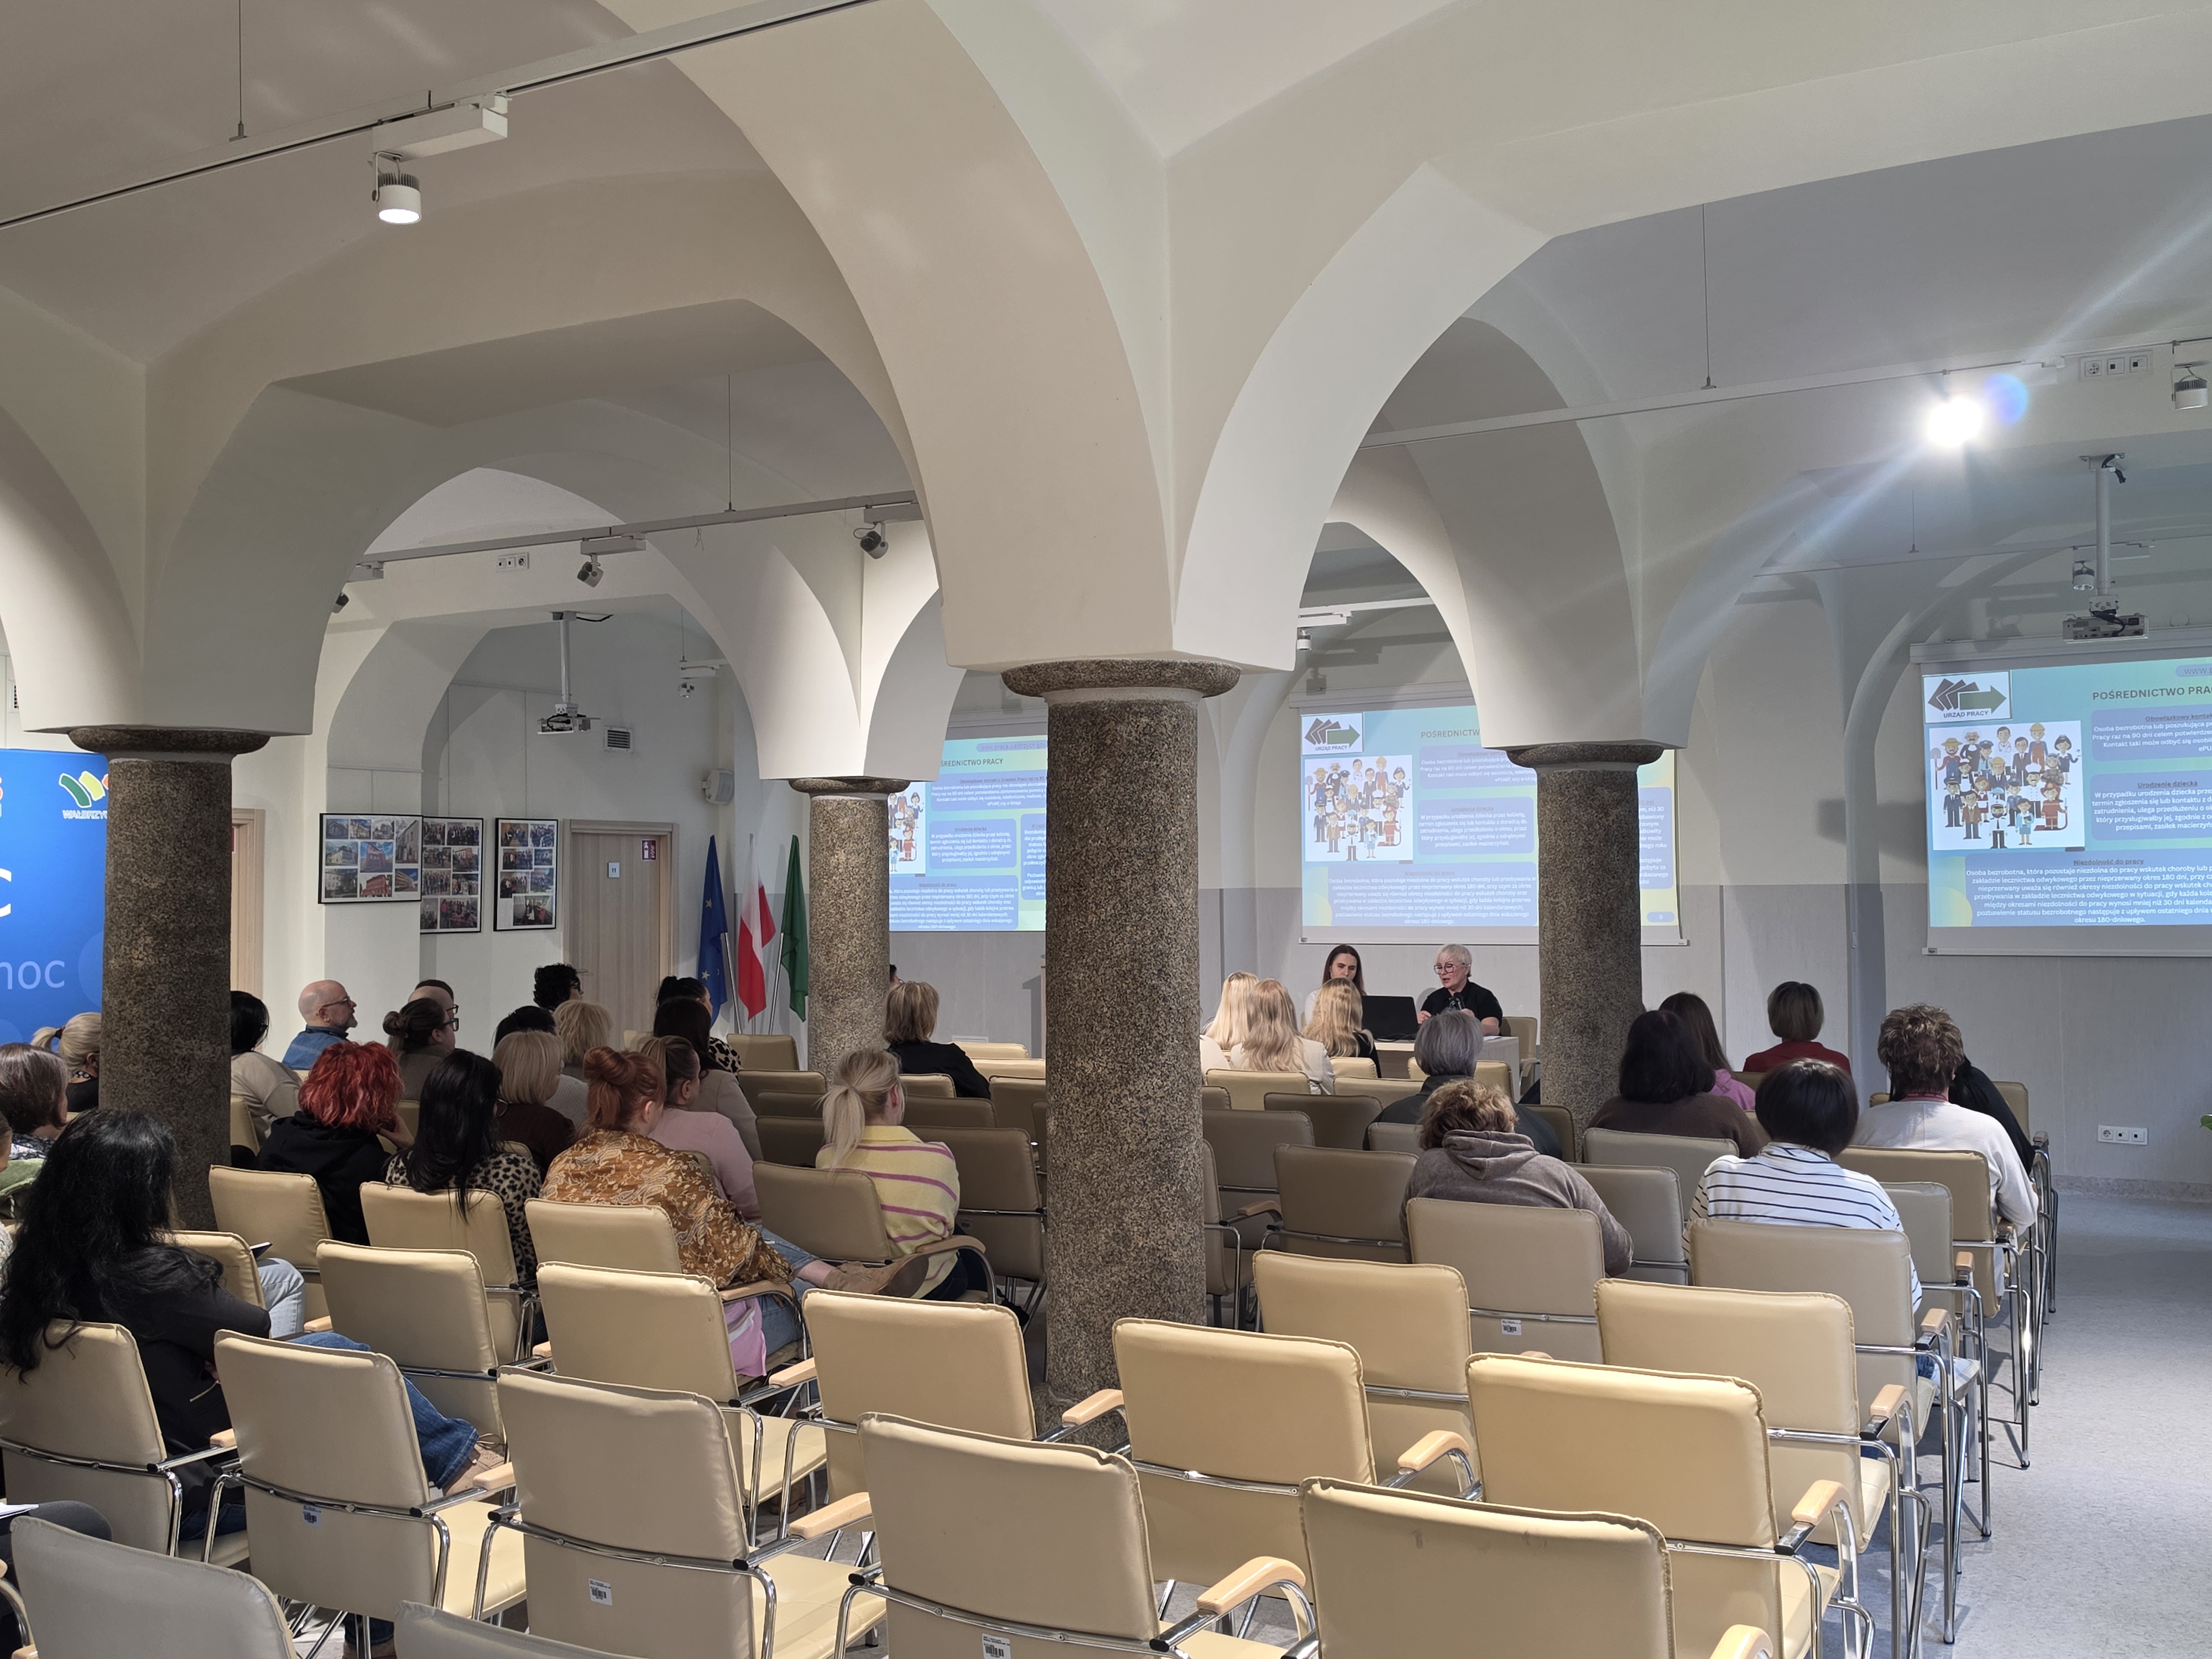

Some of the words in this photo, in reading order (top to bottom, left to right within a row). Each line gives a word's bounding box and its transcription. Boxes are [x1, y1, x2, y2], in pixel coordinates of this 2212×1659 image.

[2093, 687, 2184, 700] POŚREDNICTWO
[2188, 686, 2212, 695] PRA
[2166, 721, 2205, 730] poszukująca
[2102, 790, 2136, 799] przypadku
[2115, 798, 2148, 807] zgłoszenia
[2149, 797, 2159, 806] się
[2174, 813, 2201, 822] zgodnie
[2116, 823, 2153, 832] przepisami,
[2044, 868, 2075, 876] pozostaje
[2176, 873, 2189, 881] dni,
[2042, 884, 2052, 892] się
[1974, 893, 2013, 901] przebywania
[2136, 890, 2164, 899] sytuacji,
[1984, 901, 2007, 909] między
[2109, 899, 2132, 907] wynosi
[1977, 909, 2016, 917] pozbawienie
[2088, 907, 2120, 916] następuje
